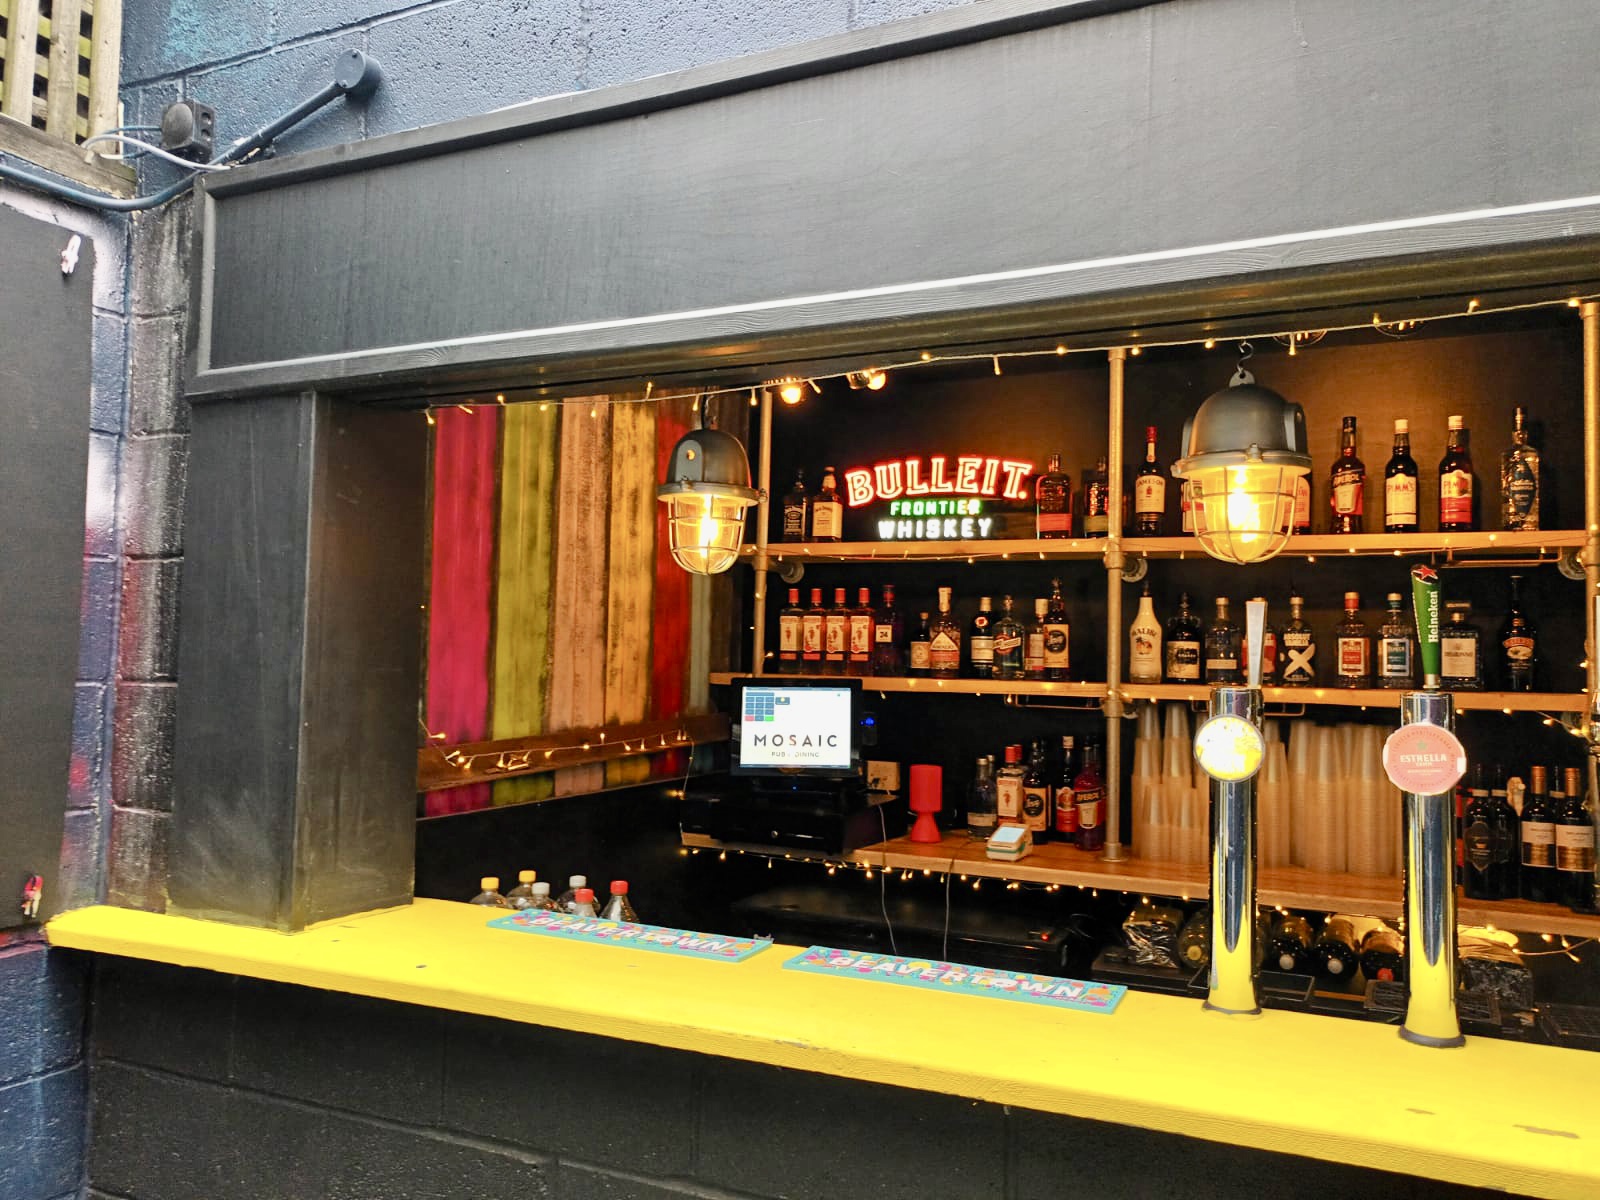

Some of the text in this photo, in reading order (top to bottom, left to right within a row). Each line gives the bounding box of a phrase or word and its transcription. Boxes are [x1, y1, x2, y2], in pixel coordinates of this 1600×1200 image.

[889, 498, 982, 516] FRONTIER
[877, 517, 993, 539] WHISKEY
[1428, 590, 1439, 643] Heineken
[753, 734, 838, 748] MOSAIC
[1400, 753, 1448, 763] ESTRELLA
[529, 916, 733, 952] BEAVERTOWN
[829, 956, 1085, 999] BEAVERTOWN
